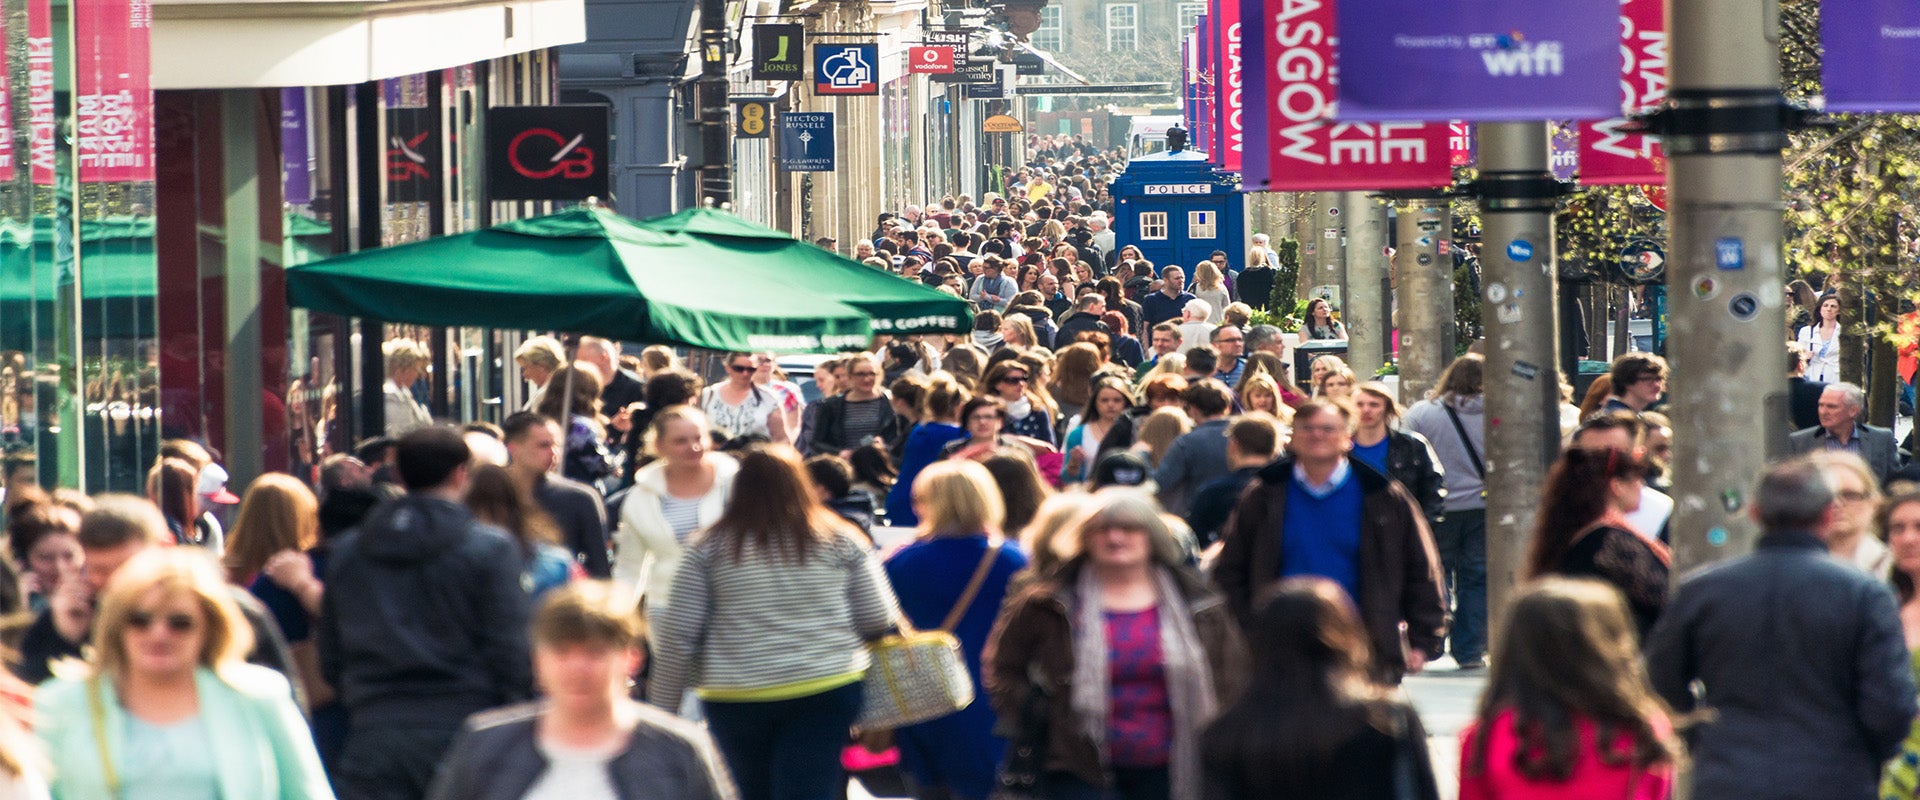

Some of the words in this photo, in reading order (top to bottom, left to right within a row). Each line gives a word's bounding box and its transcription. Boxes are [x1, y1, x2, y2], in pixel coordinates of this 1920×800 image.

[926, 33, 966, 43] LUSH
[1481, 41, 1563, 76] wifi
[759, 62, 798, 73] JONES
[785, 114, 826, 122] HECTOR
[1148, 185, 1206, 194] POLICE
[895, 316, 958, 330] COFFEE
